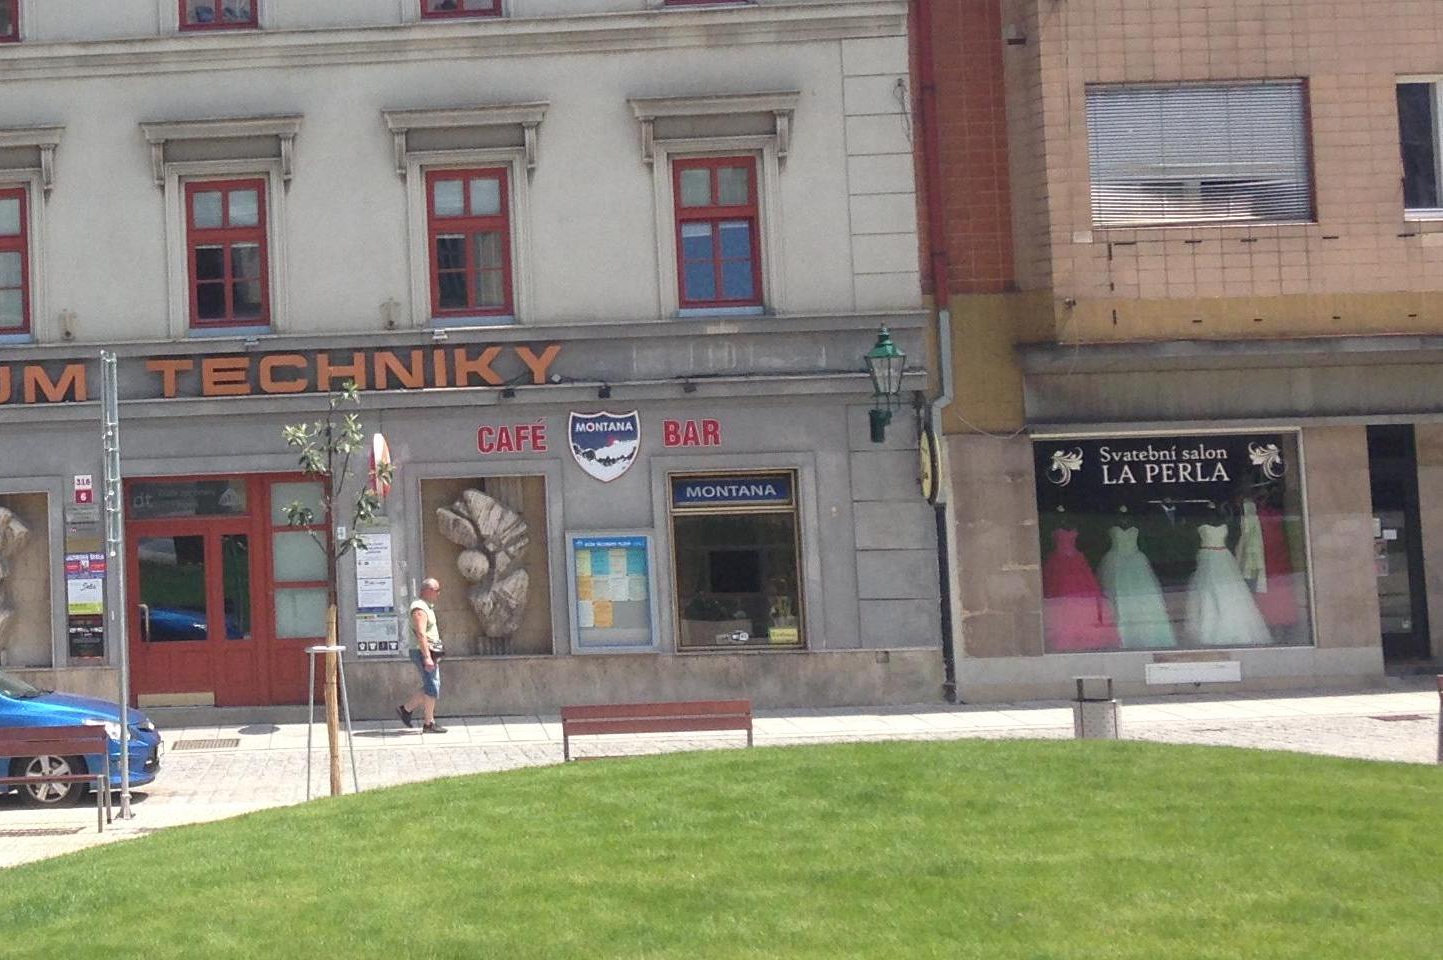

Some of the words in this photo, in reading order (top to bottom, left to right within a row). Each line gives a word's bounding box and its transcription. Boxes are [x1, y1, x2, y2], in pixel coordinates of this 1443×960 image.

[145, 344, 562, 398] TECHNIKY
[476, 417, 548, 454] CAFÉ
[575, 420, 634, 433] MONTANA
[662, 418, 722, 448] BAR
[1099, 445, 1177, 462] Svatební
[1182, 443, 1228, 460] salon
[1102, 464, 1137, 484] LA
[1145, 461, 1231, 484] PERLA
[80, 491, 87, 502] 6
[685, 483, 778, 499] MONTANA
